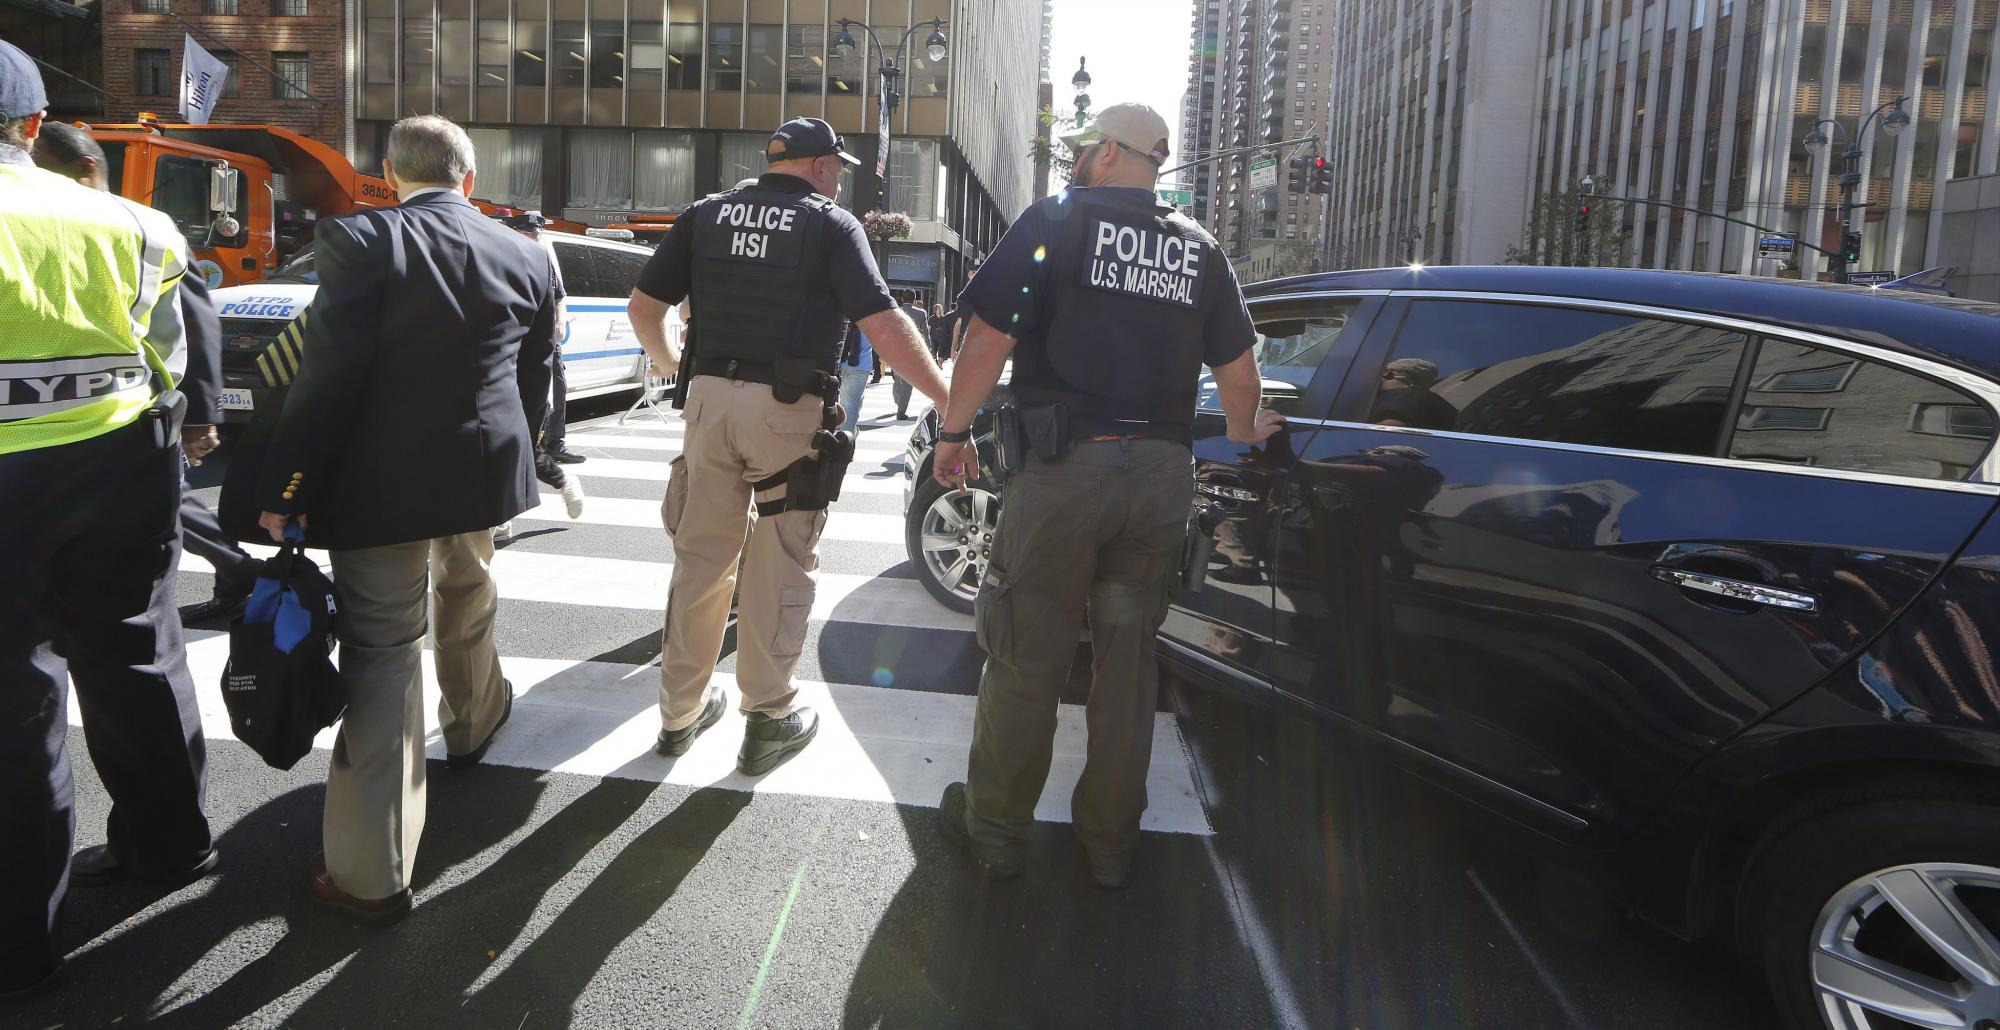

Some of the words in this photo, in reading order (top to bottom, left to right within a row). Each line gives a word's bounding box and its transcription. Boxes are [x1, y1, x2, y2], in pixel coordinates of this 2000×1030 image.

[188, 71, 211, 110] Hilton
[1166, 193, 1179, 202] St
[716, 203, 796, 231] POLICE
[731, 231, 768, 258] HSI
[1095, 221, 1201, 277] POLICE
[1091, 258, 1119, 289] U.S.
[1124, 265, 1193, 305] MARSHAL
[1850, 275, 1873, 283] Second
[220, 303, 294, 317] POLICE
[242, 296, 293, 304] NYPD
